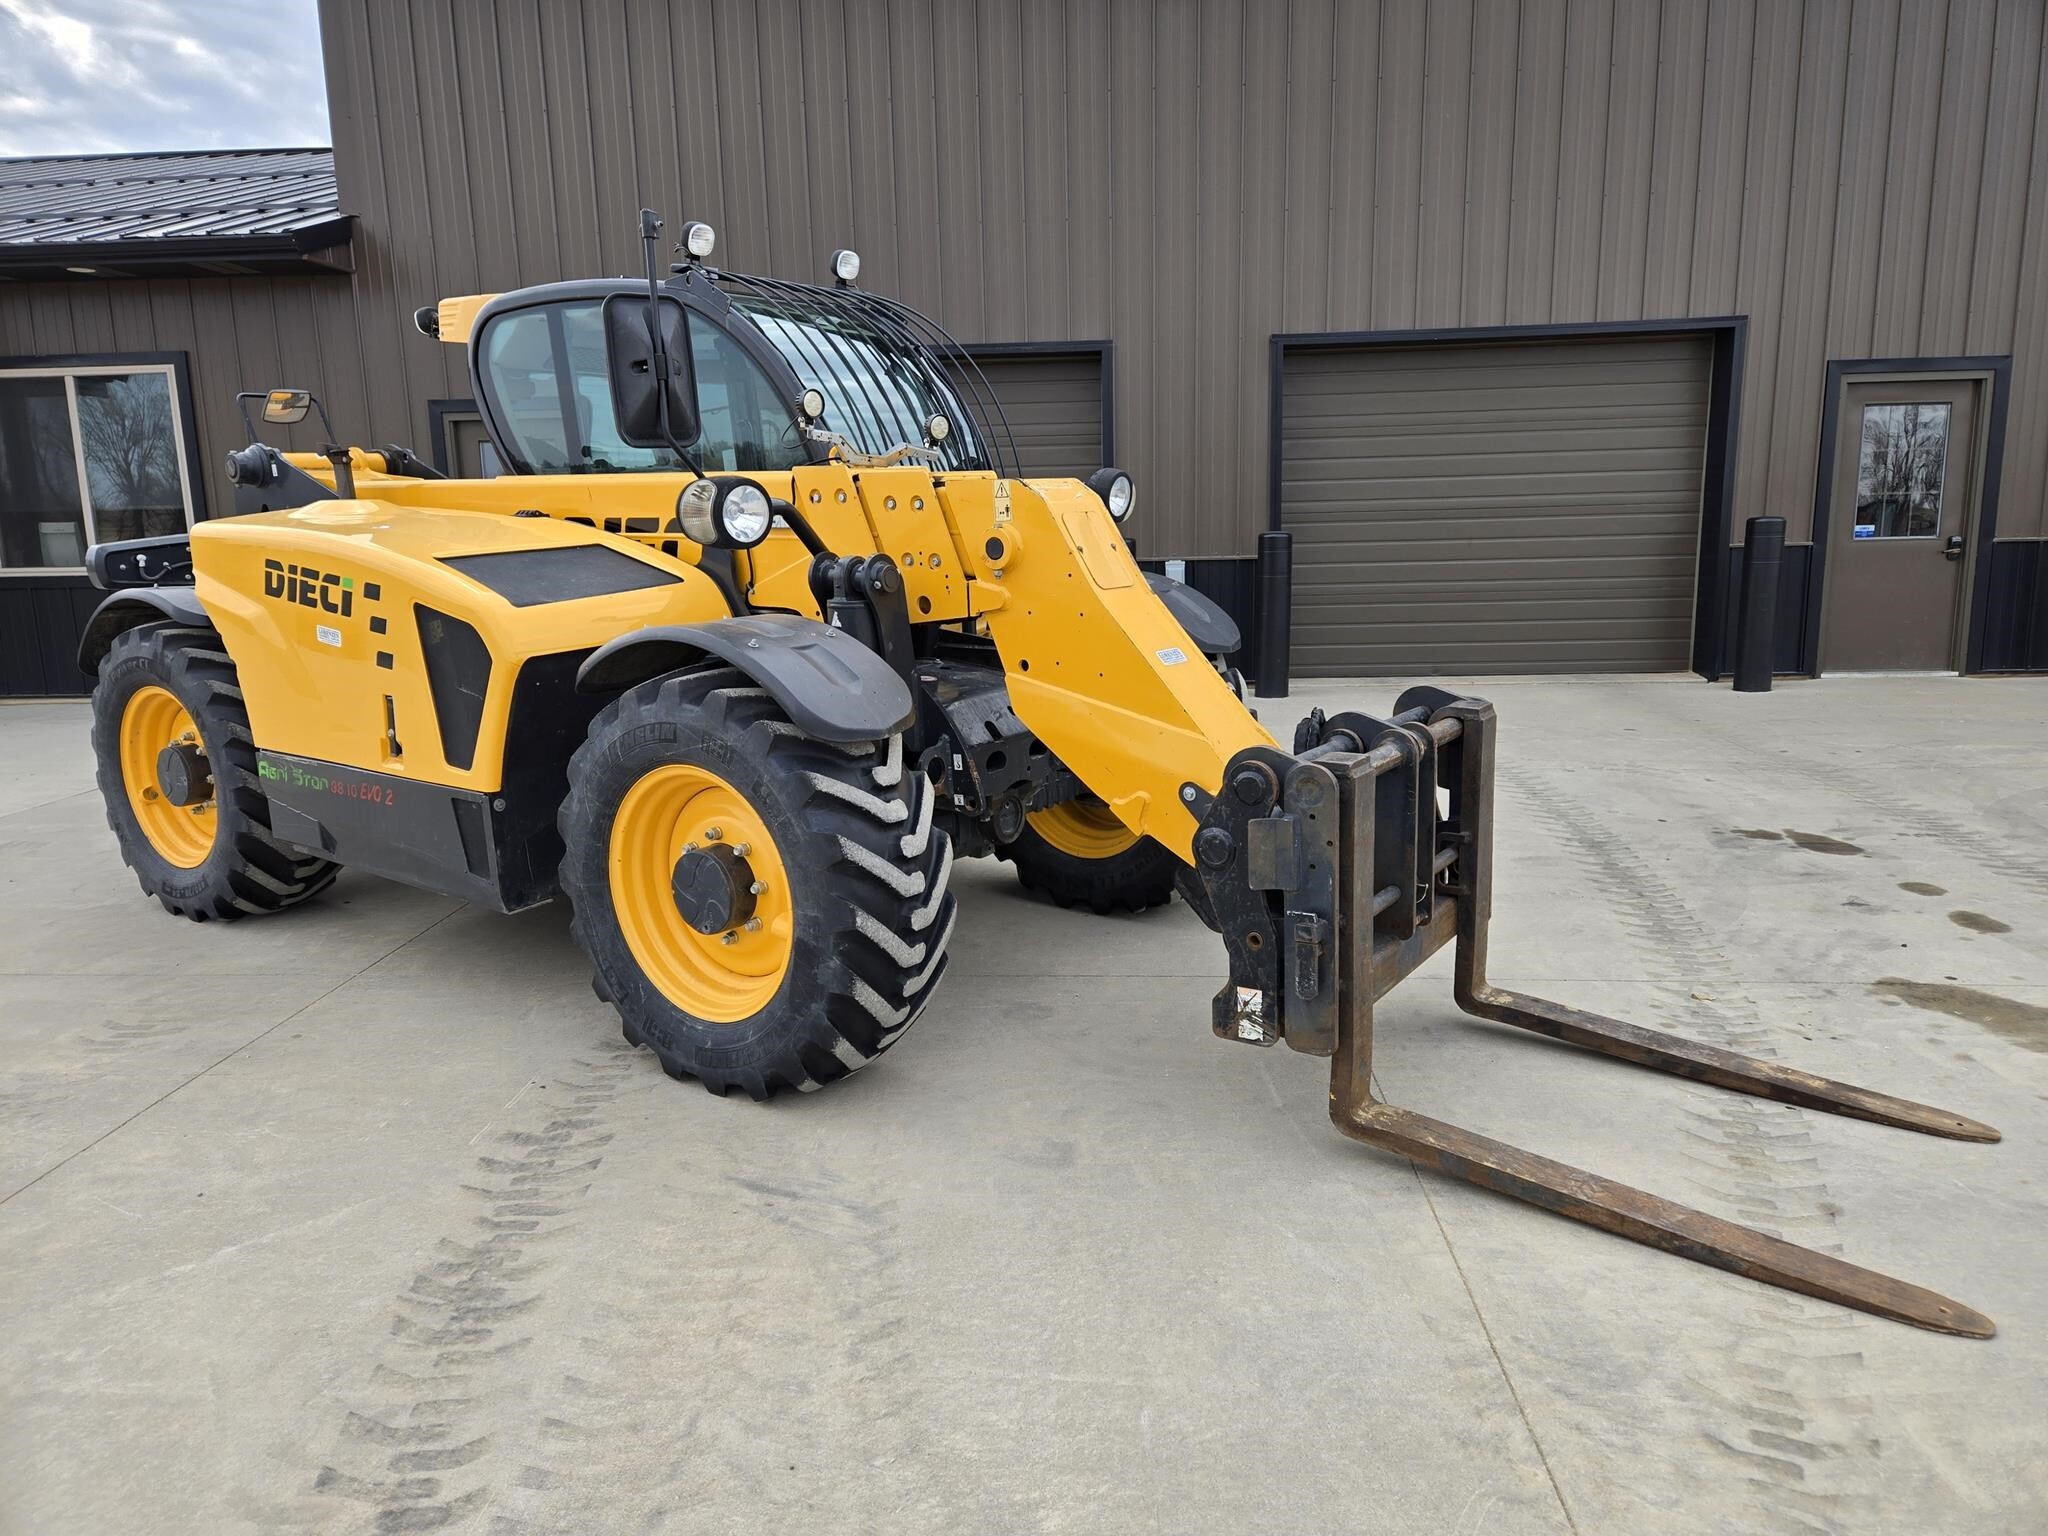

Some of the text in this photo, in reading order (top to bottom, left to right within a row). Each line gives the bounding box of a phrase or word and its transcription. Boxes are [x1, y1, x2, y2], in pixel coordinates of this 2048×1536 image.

[264, 558, 353, 618] DIECI
[361, 783, 381, 803] EVO
[385, 789, 393, 806] 2
